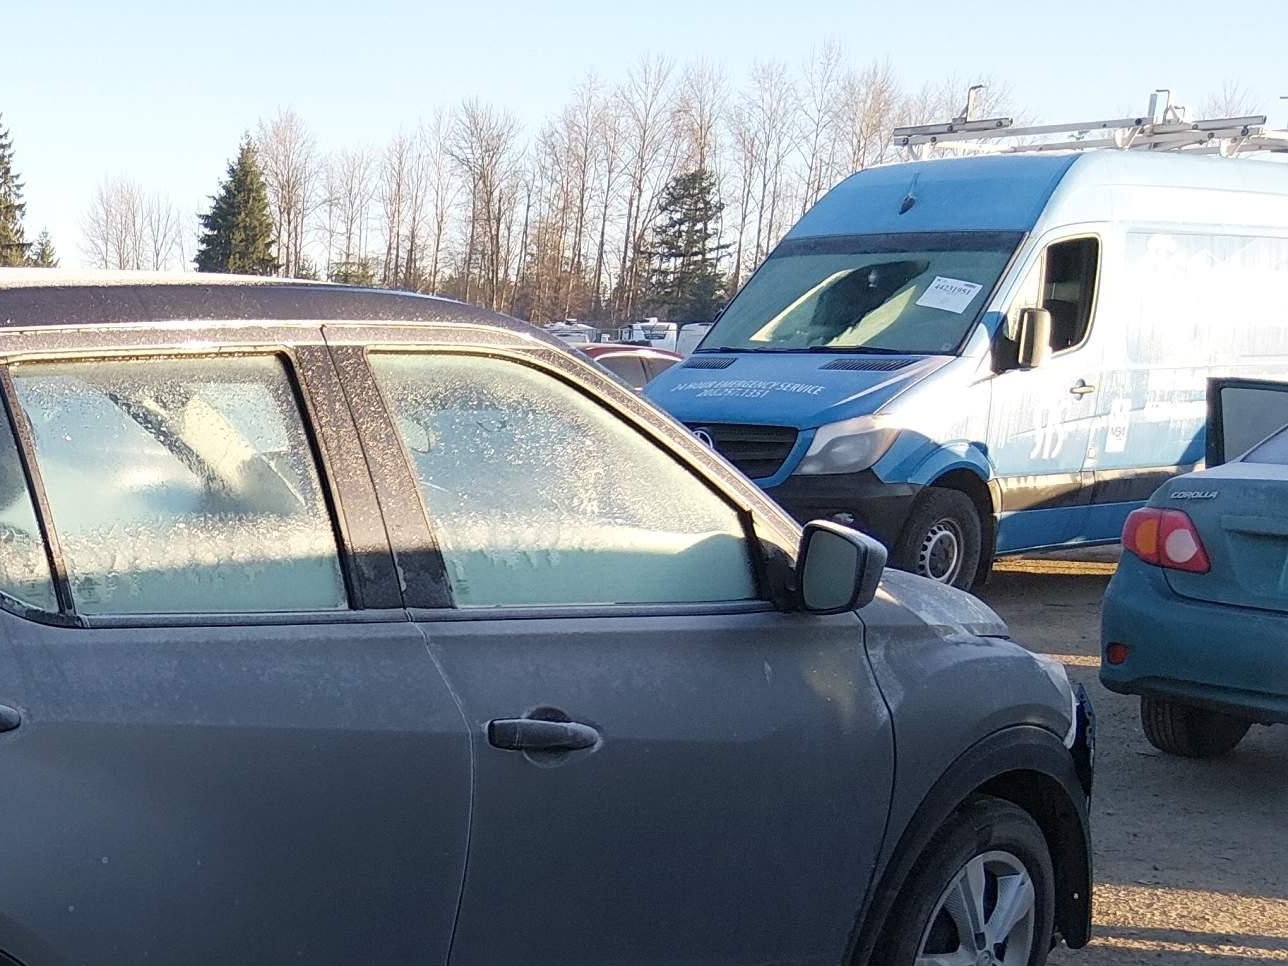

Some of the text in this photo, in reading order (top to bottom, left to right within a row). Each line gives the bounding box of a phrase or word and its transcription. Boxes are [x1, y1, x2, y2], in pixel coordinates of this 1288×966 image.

[685, 380, 716, 391] HOUR
[714, 379, 779, 390] EMERGENCY
[776, 383, 826, 396] SERVICE
[1170, 491, 1218, 500] COROLLA
